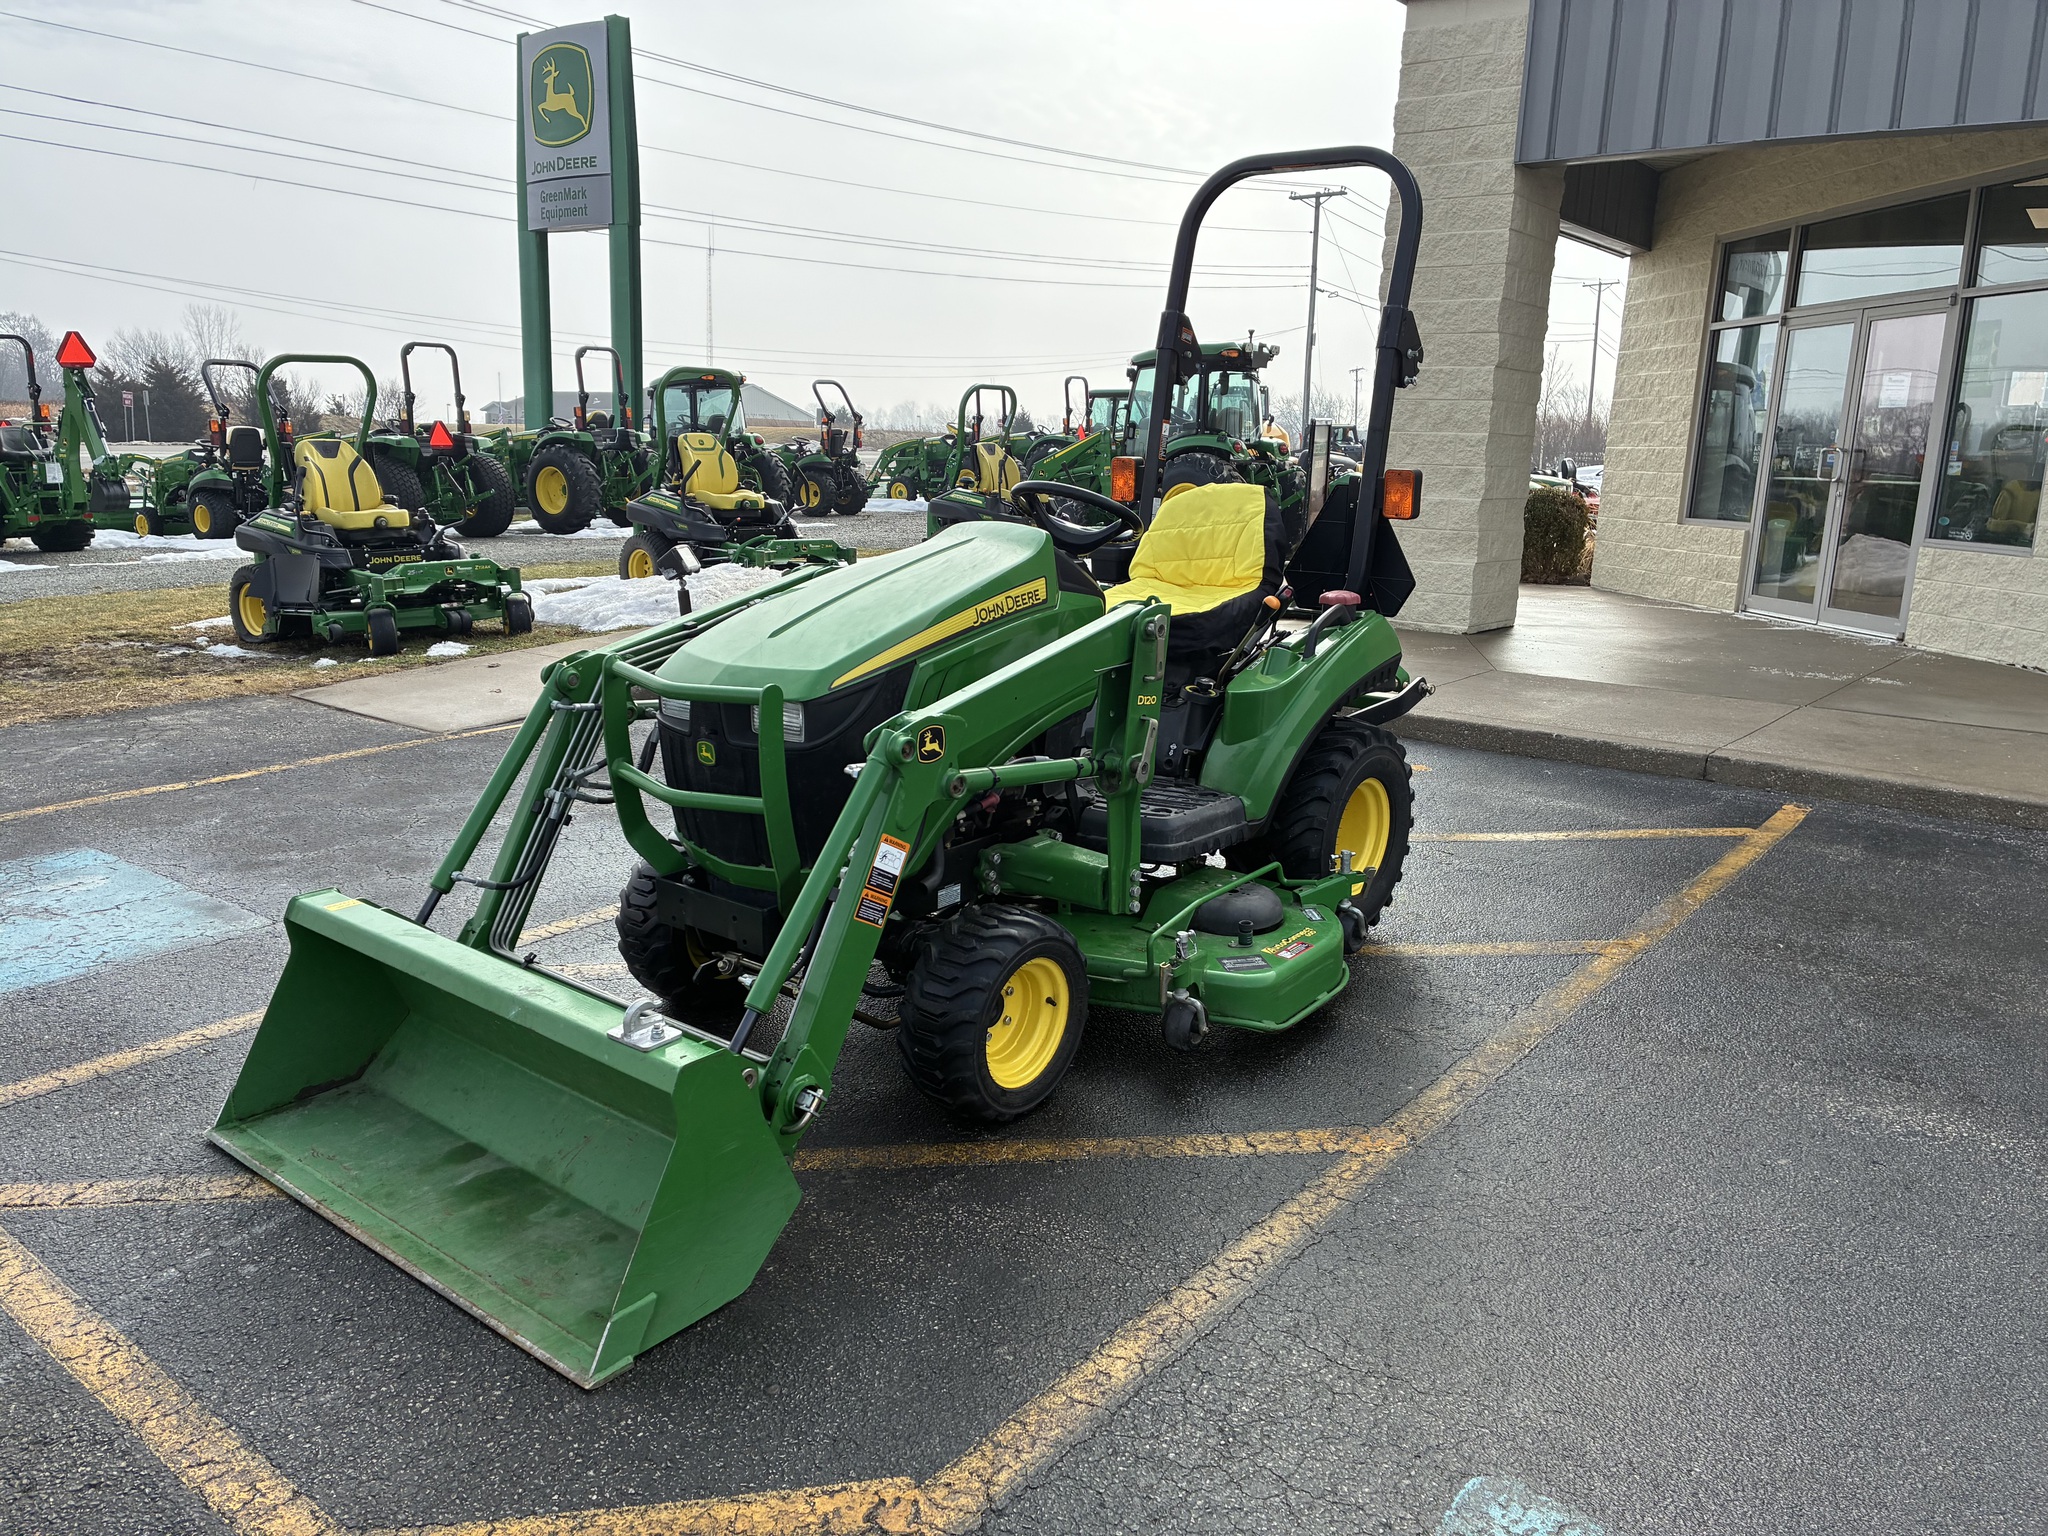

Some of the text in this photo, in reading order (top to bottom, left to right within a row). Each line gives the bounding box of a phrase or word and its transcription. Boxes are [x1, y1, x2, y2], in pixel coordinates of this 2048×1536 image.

[531, 156, 597, 176] JOHN DEERE
[540, 186, 587, 203] GreenMark
[541, 203, 588, 222] Equipment
[369, 554, 422, 565] JOHN DEERE
[973, 589, 1041, 625] JOHN DEERE
[1137, 695, 1157, 705] D120
